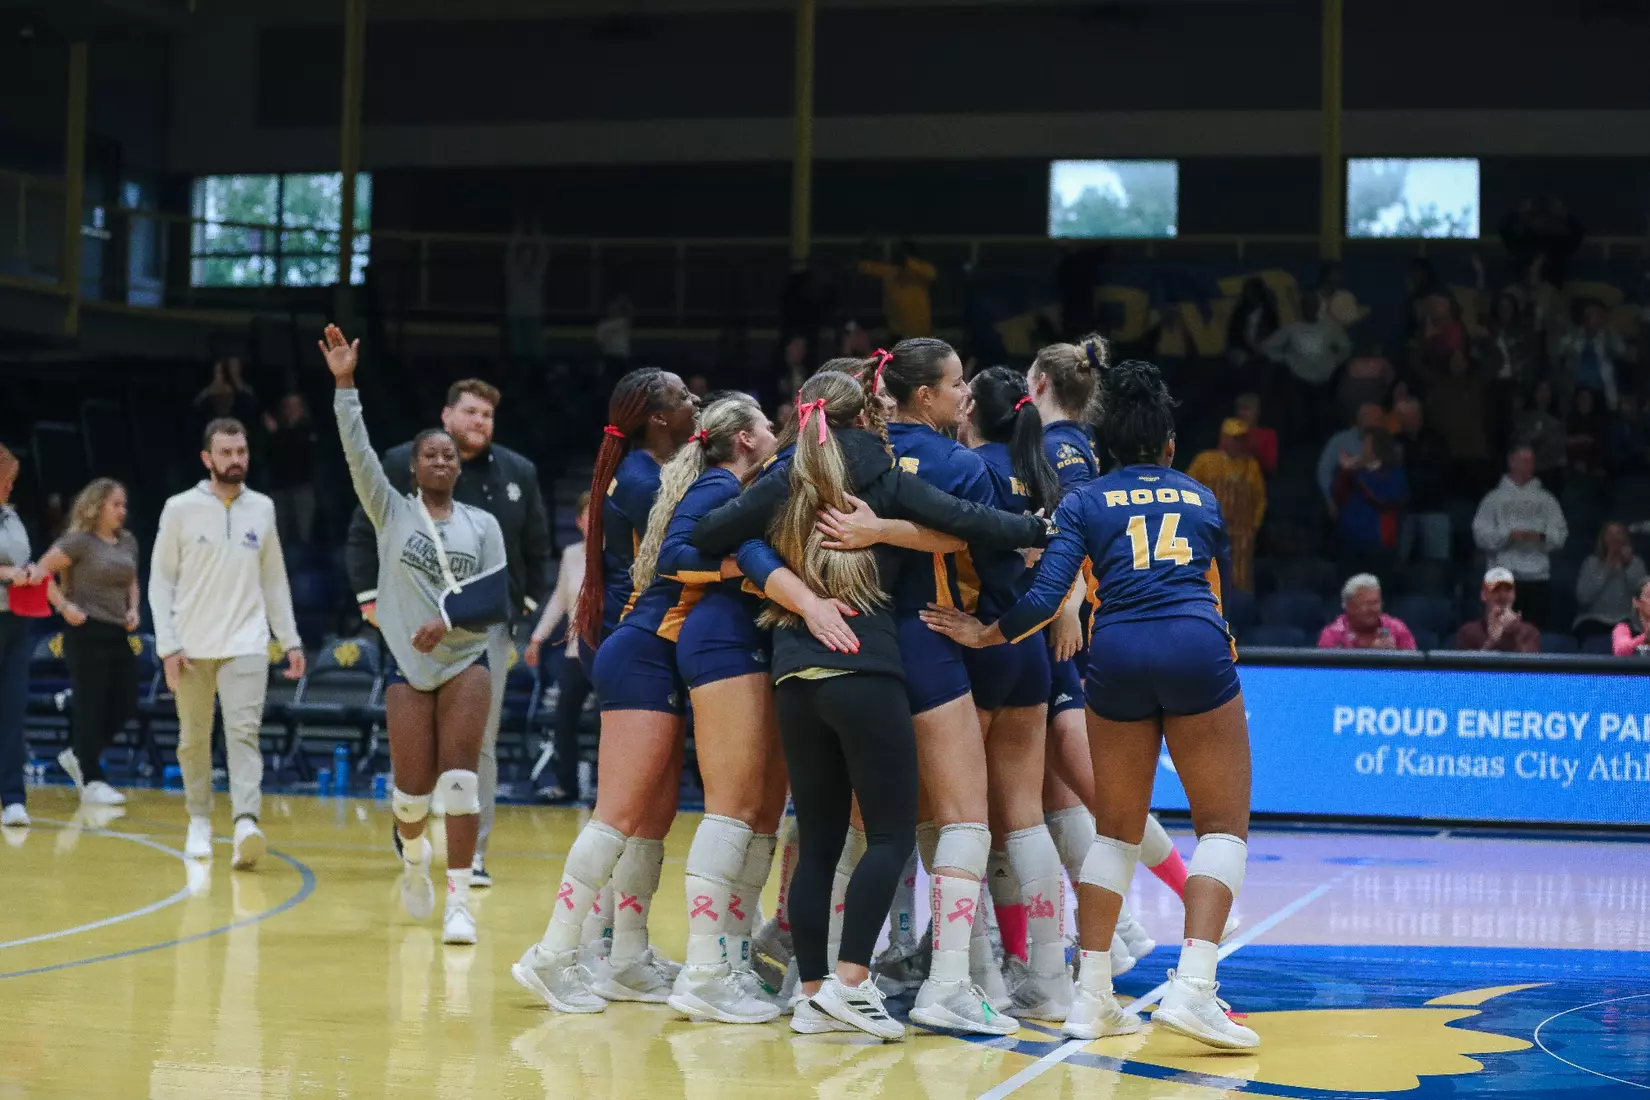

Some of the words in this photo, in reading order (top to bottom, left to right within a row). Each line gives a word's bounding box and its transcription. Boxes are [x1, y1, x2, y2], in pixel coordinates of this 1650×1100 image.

[1103, 488, 1202, 507] ROOS
[1126, 513, 1193, 570] 14
[1333, 706, 1447, 736] PROUD
[1457, 710, 1590, 740] ENERGY
[1355, 745, 1389, 775] of
[1395, 747, 1504, 778] Kansas
[1514, 751, 1579, 788] City
